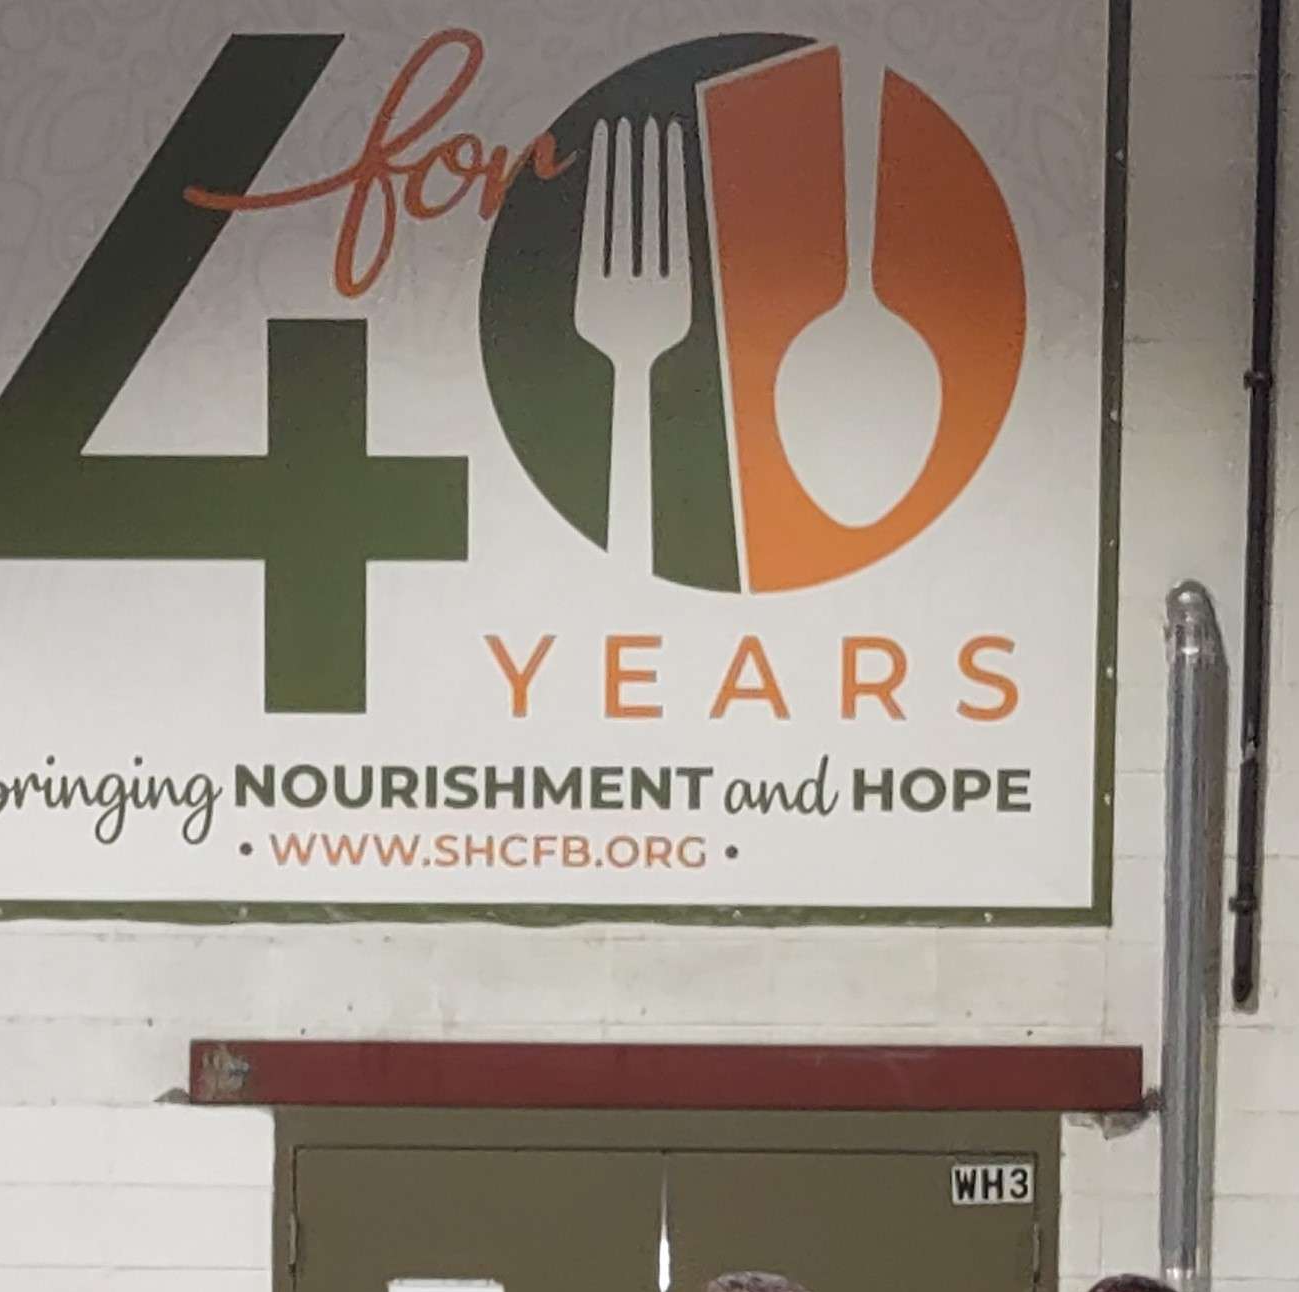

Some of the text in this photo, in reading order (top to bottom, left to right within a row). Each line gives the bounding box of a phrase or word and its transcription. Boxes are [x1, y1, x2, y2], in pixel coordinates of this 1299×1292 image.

[184, 28, 577, 298] for
[483, 635, 1022, 721] YEARS
[234, 763, 714, 811] NOURISHMENT
[723, 754, 839, 817] and
[852, 767, 1032, 813] HOPE
[269, 832, 707, 870] WWW.SHCFB.ORG
[954, 1168, 1029, 1200] WH3
